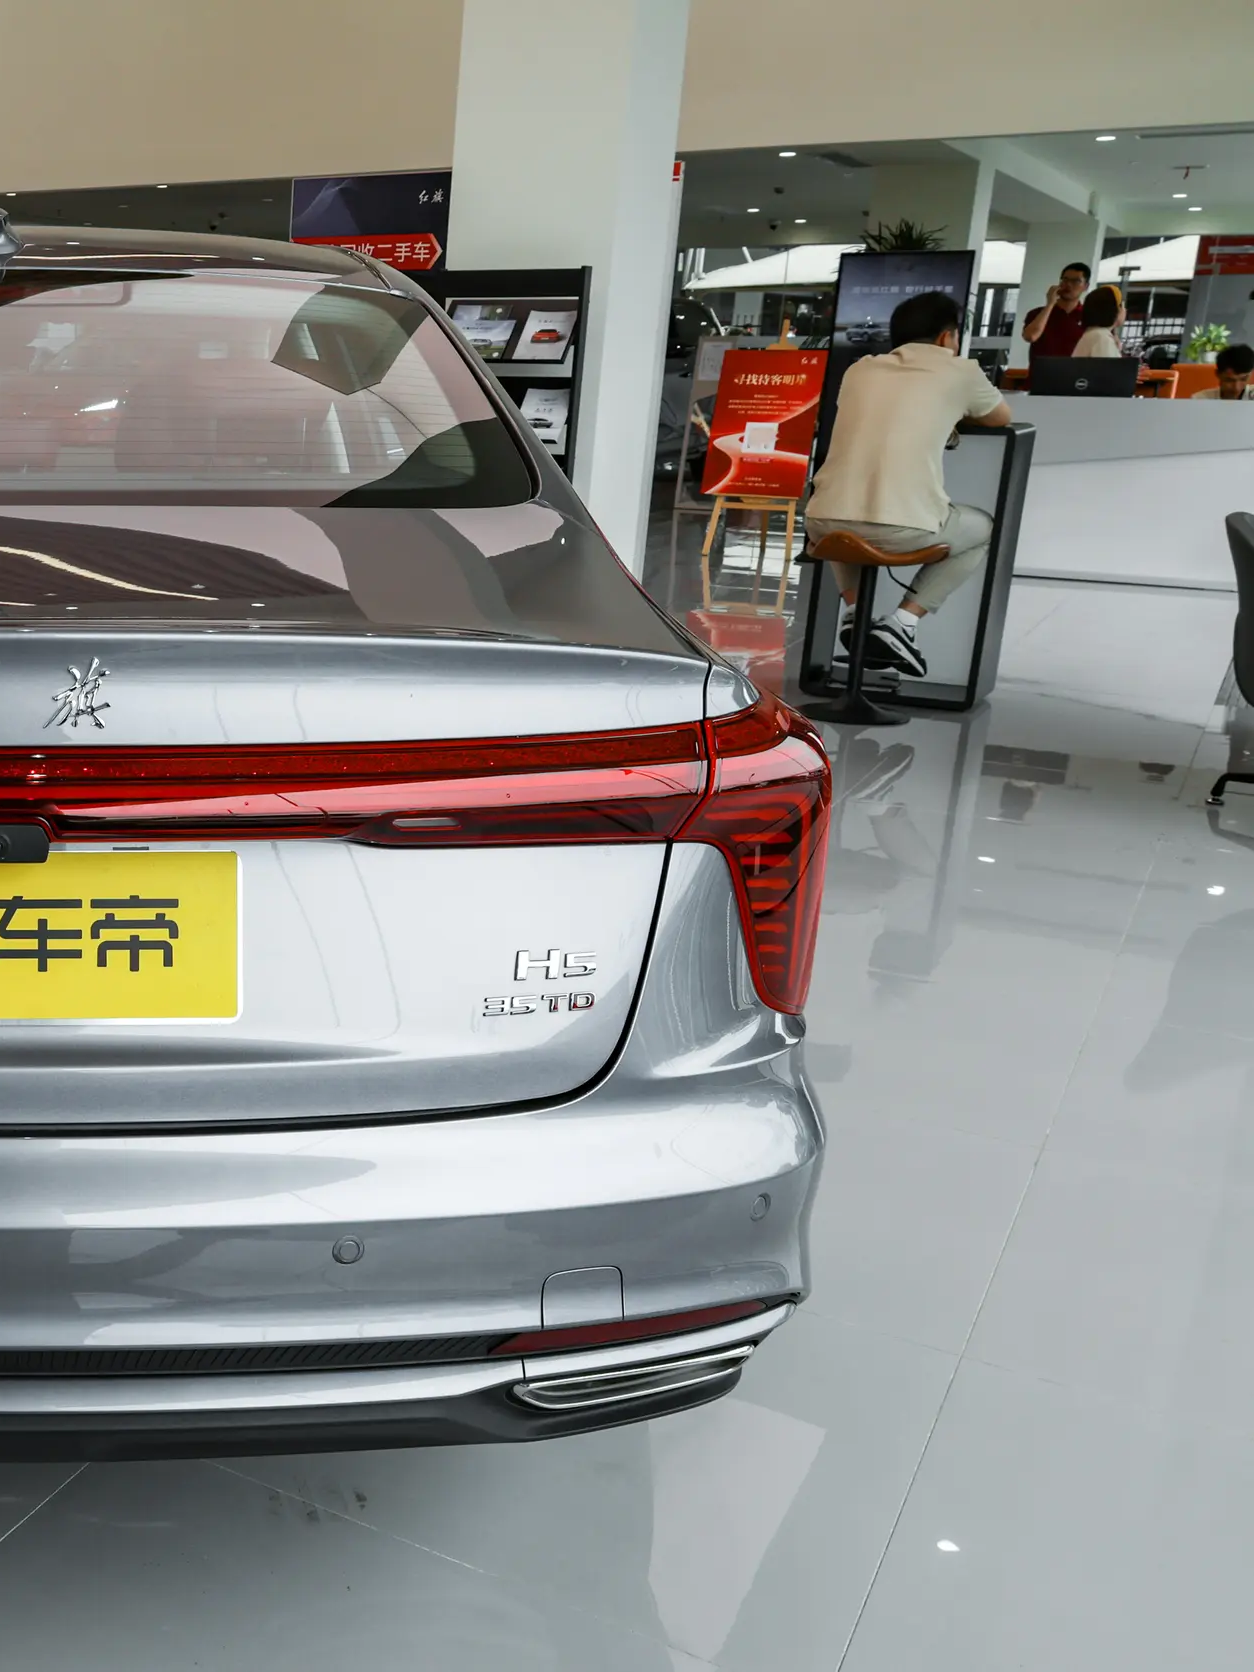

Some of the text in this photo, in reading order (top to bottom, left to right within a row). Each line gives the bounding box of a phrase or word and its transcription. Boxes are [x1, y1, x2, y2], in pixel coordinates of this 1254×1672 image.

[419, 189, 444, 204] 红旗
[340, 242, 431, 262] 收二手车
[513, 948, 597, 981] H5
[482, 991, 597, 1017] 35TD
